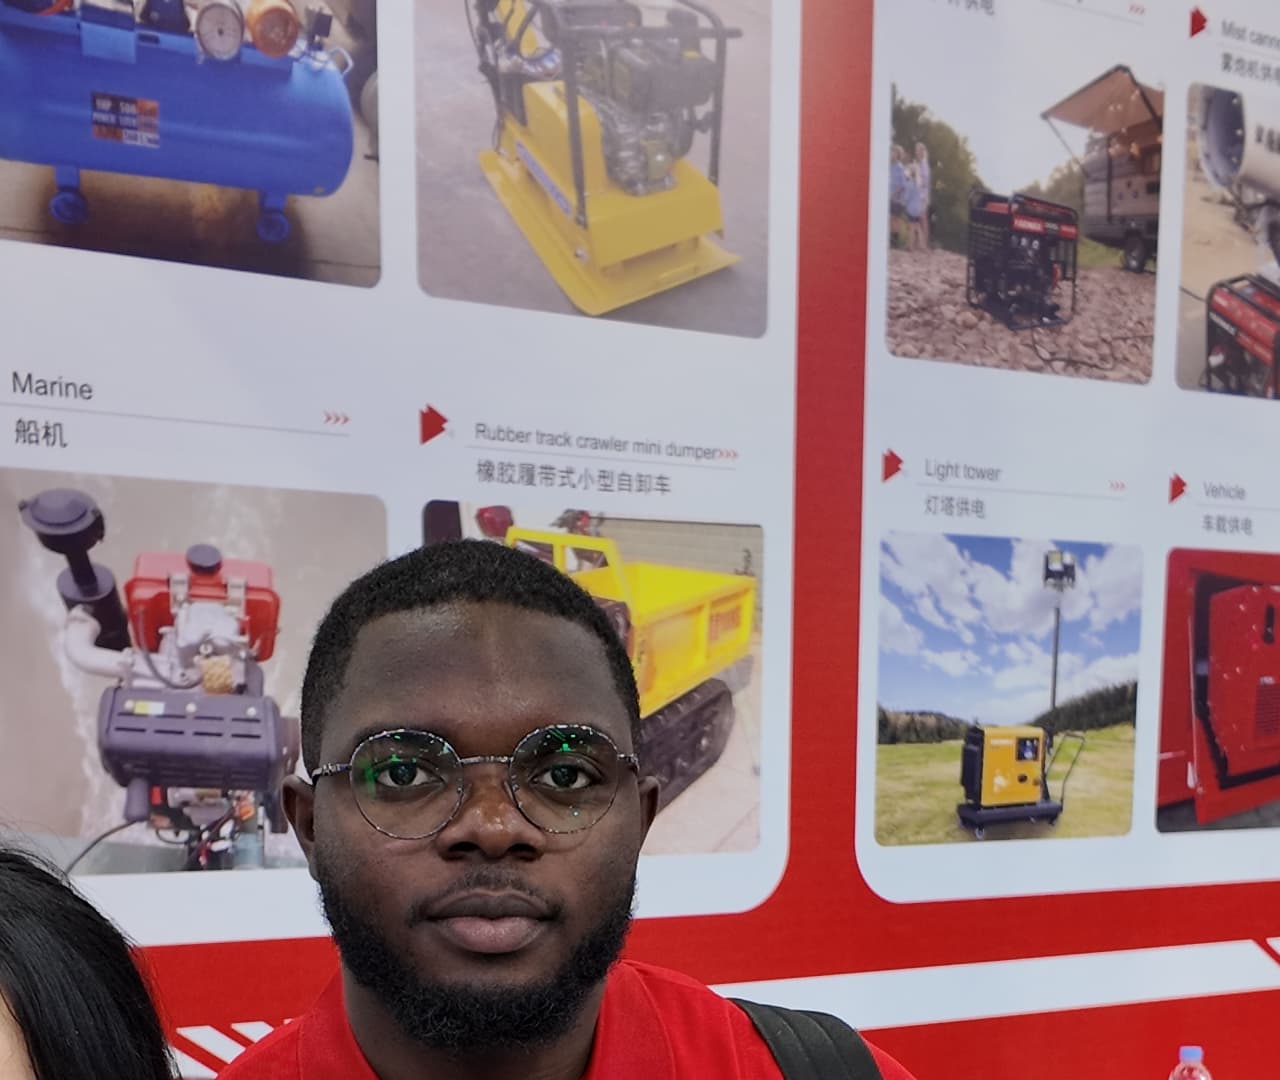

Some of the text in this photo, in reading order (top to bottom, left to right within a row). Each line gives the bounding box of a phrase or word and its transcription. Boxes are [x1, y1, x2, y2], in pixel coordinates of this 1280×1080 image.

[1222, 20, 1247, 41] Mist
[12, 371, 93, 400] Marine
[15, 418, 68, 448] 船机
[475, 423, 717, 461] Rubber track crawler mini dumper
[477, 458, 671, 495] 橡胶履带式小型自卸车
[925, 459, 1002, 482] Light tower
[1202, 481, 1247, 501] Vehicle
